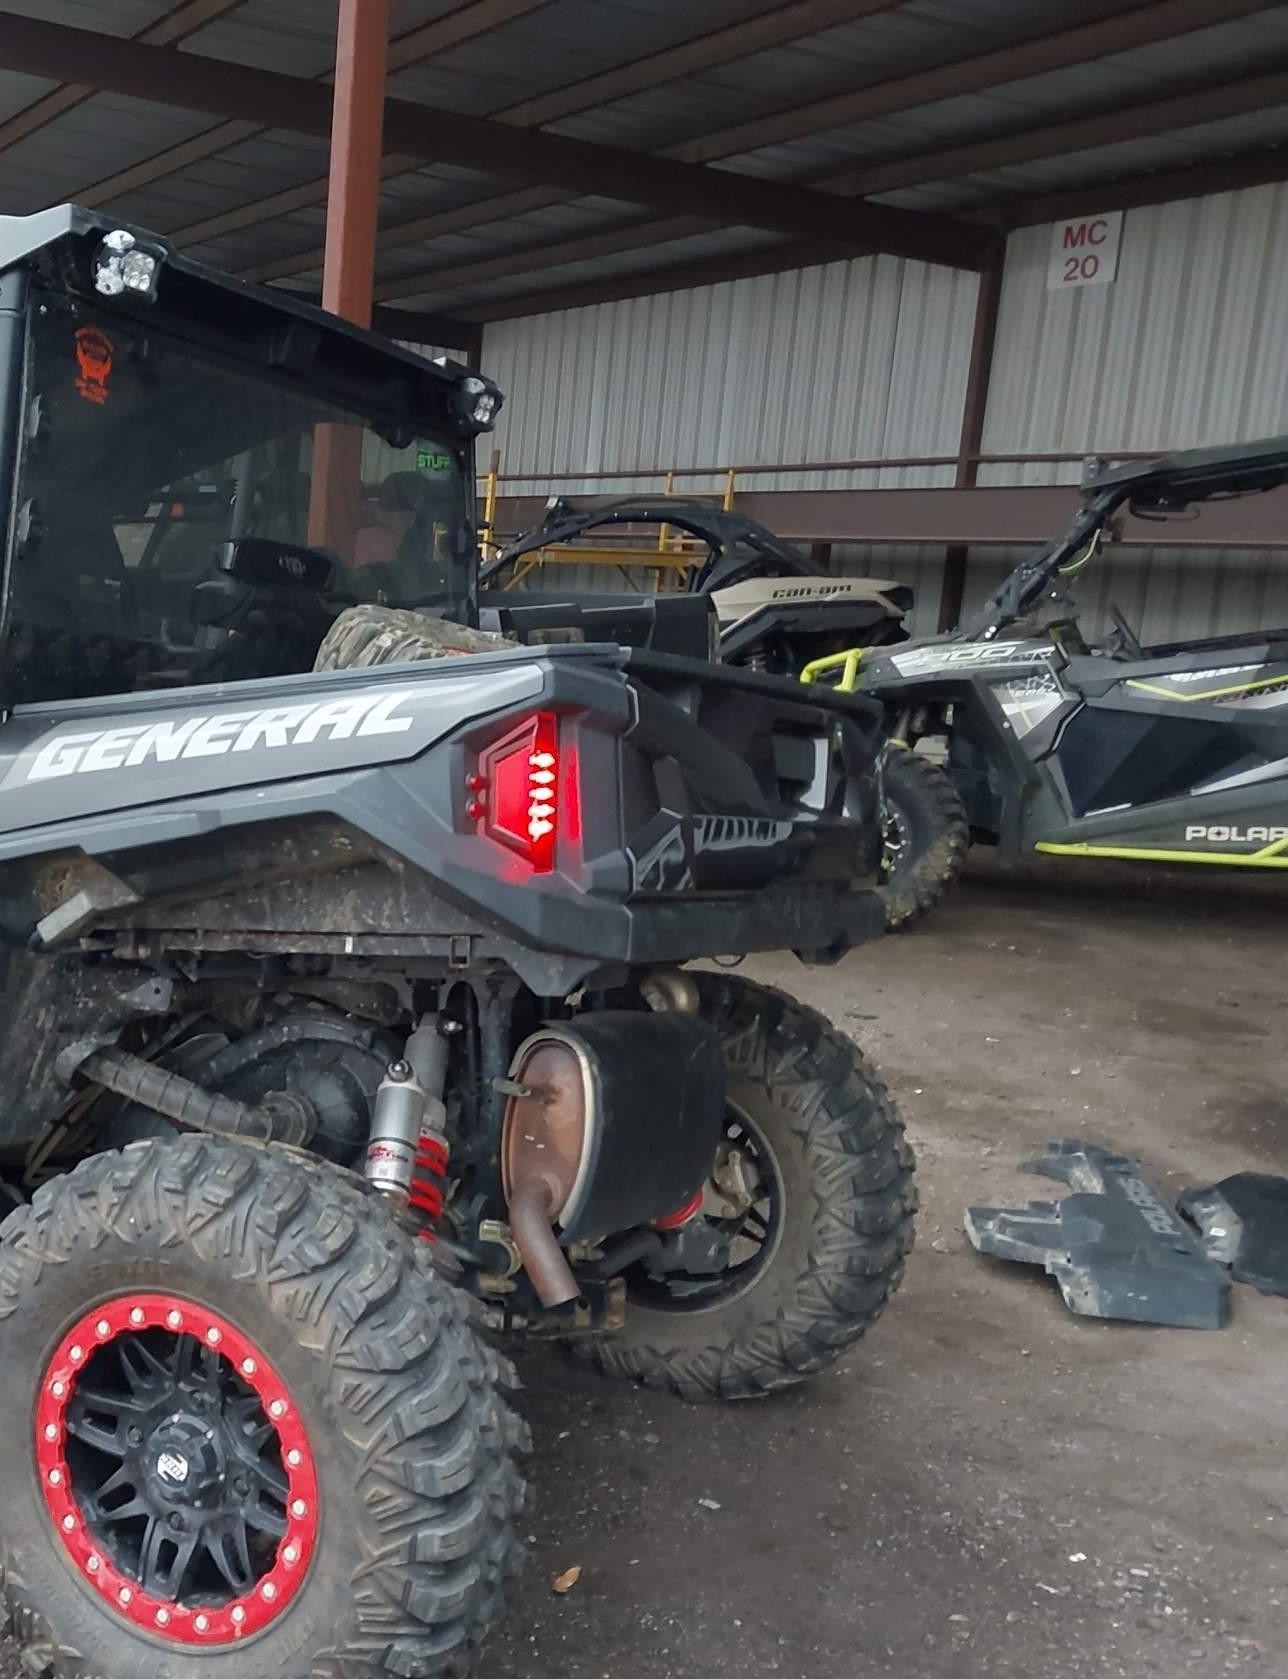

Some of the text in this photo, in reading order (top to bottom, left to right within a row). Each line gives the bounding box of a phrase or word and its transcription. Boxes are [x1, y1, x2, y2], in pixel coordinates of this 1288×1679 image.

[1063, 220, 1107, 249] MC
[1063, 254, 1099, 282] 20
[26, 691, 415, 780] GENERAL
